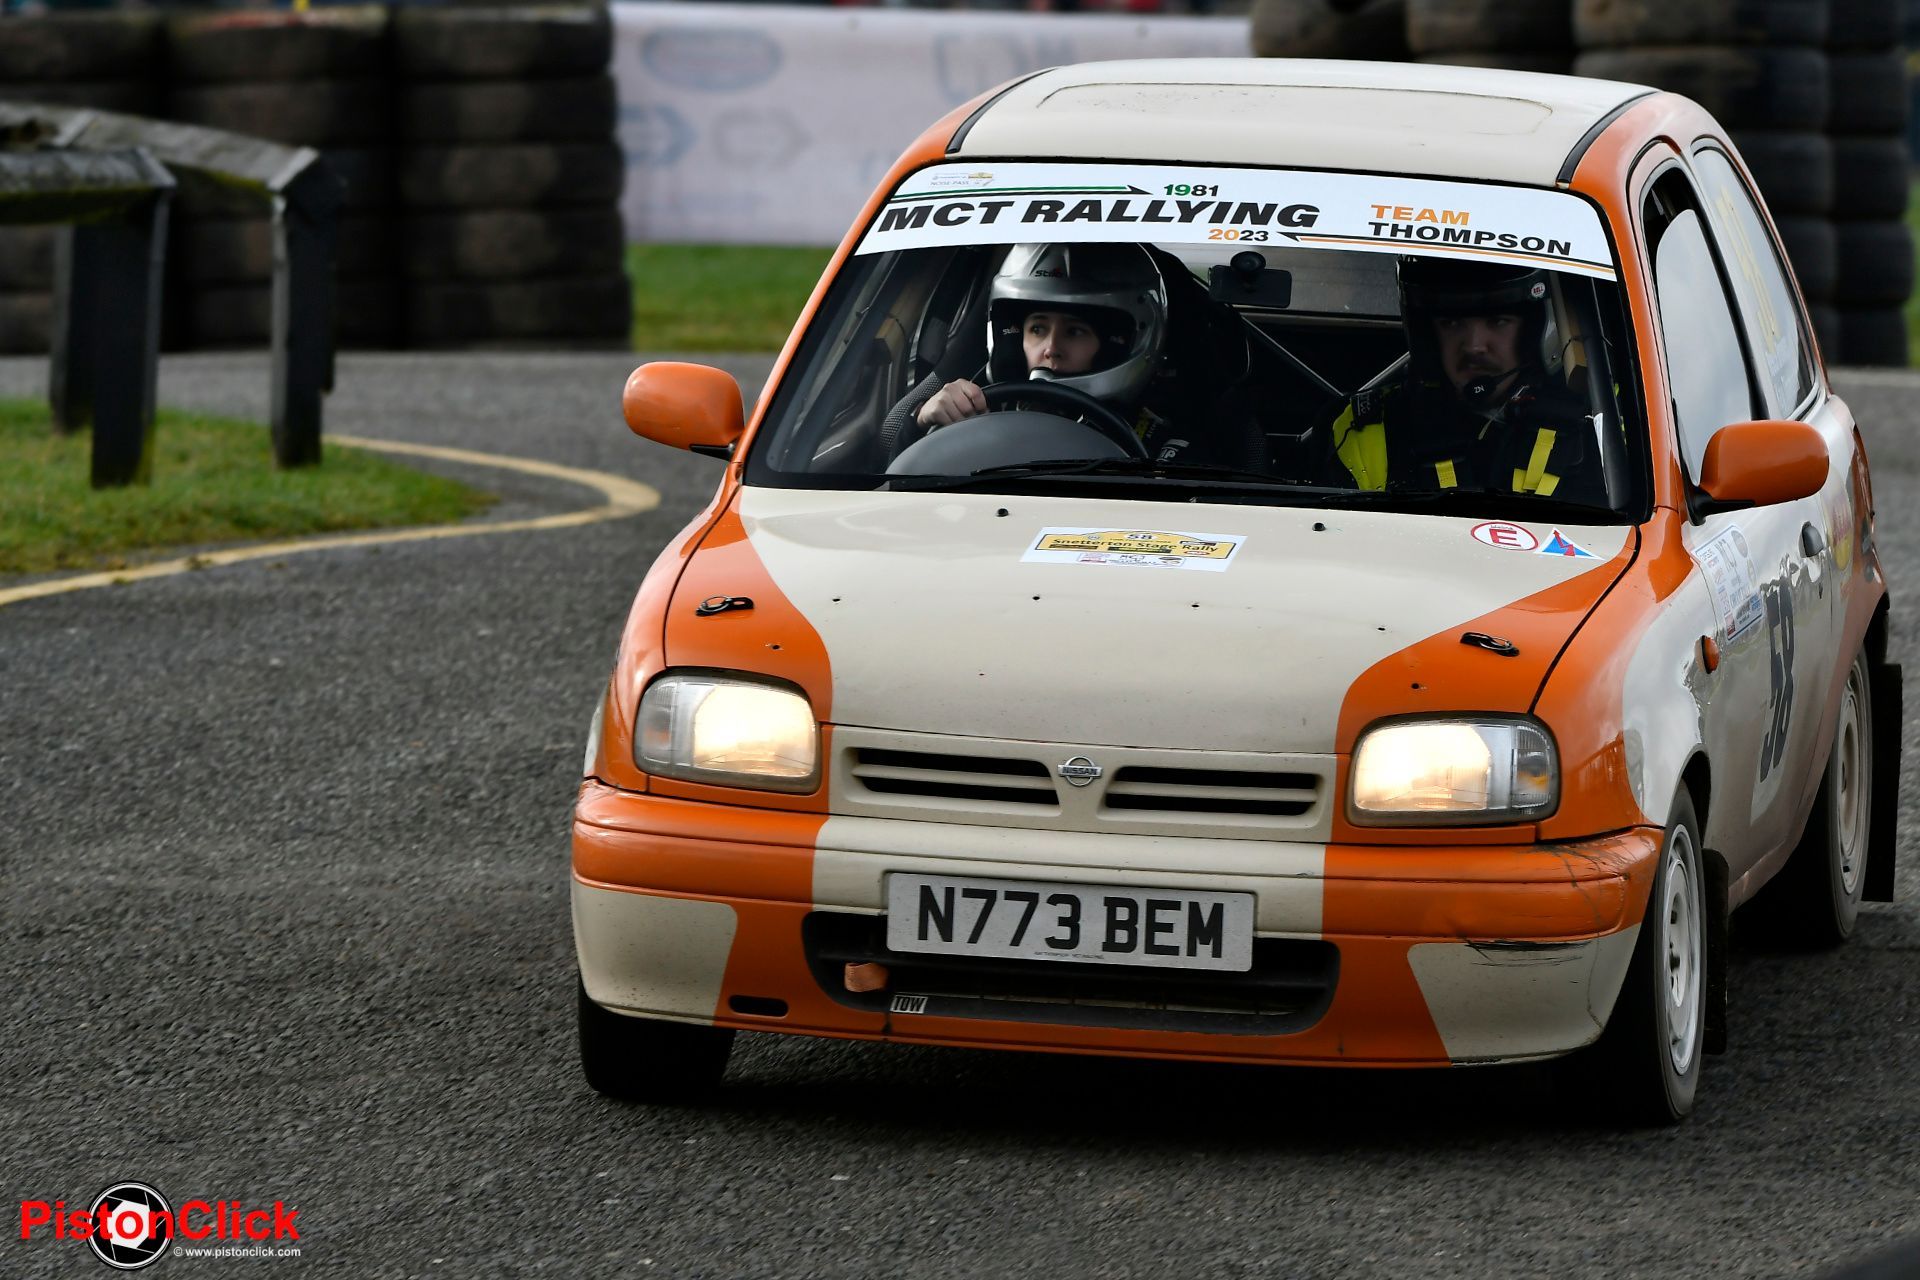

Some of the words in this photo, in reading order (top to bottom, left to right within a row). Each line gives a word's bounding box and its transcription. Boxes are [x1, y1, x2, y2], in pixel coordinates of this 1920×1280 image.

[1163, 183, 1220, 198] 1981
[877, 201, 1016, 231] MCT
[1021, 200, 1320, 228] RALLYING
[1371, 204, 1470, 226] TEAM
[1208, 228, 1269, 242] 2023
[1368, 221, 1572, 256] THOMPSON
[1052, 538, 1132, 547] Snetterton
[1138, 541, 1177, 550] Stage
[1183, 544, 1219, 553] Rally
[1488, 528, 1521, 547] E
[1759, 576, 1794, 782] 58
[1062, 766, 1098, 775] NISSAN
[917, 884, 1081, 950] N773
[1102, 896, 1224, 958] BEM
[893, 995, 925, 1013] TOW
